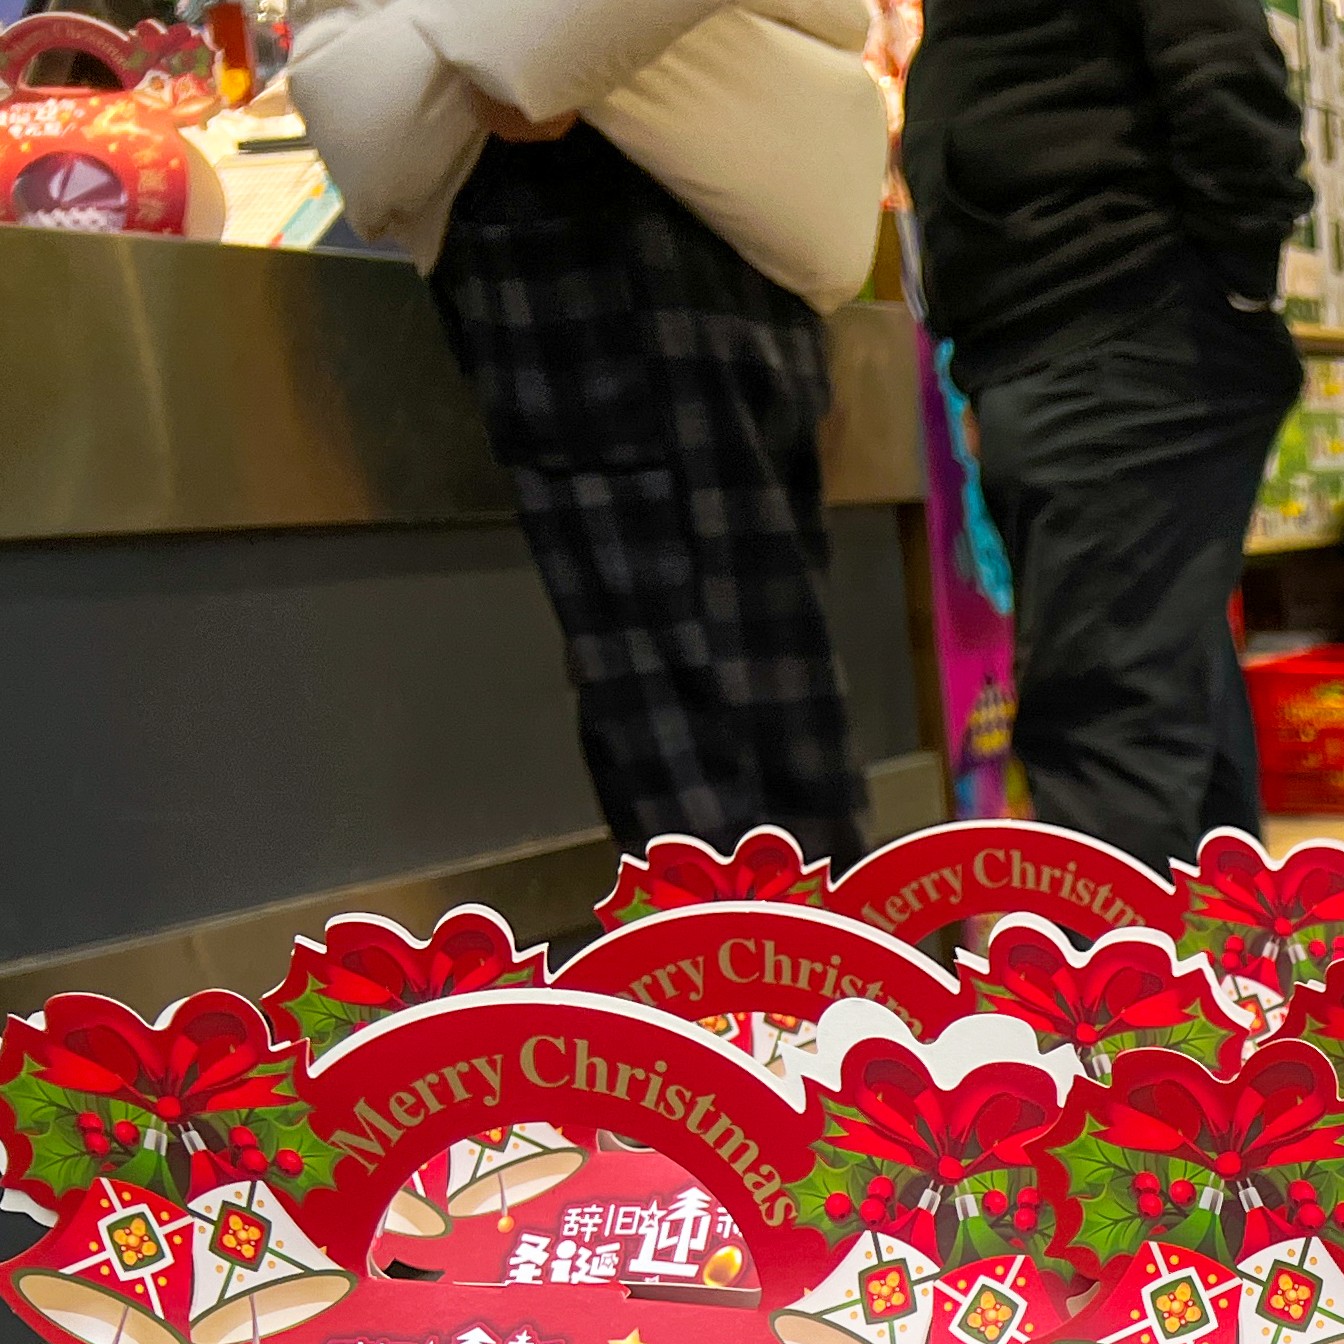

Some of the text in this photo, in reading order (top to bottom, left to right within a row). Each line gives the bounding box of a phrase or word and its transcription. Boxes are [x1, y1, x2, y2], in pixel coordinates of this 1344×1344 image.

[972, 847, 1147, 929] Christm
[329, 1034, 799, 1228] Merry Christmas
